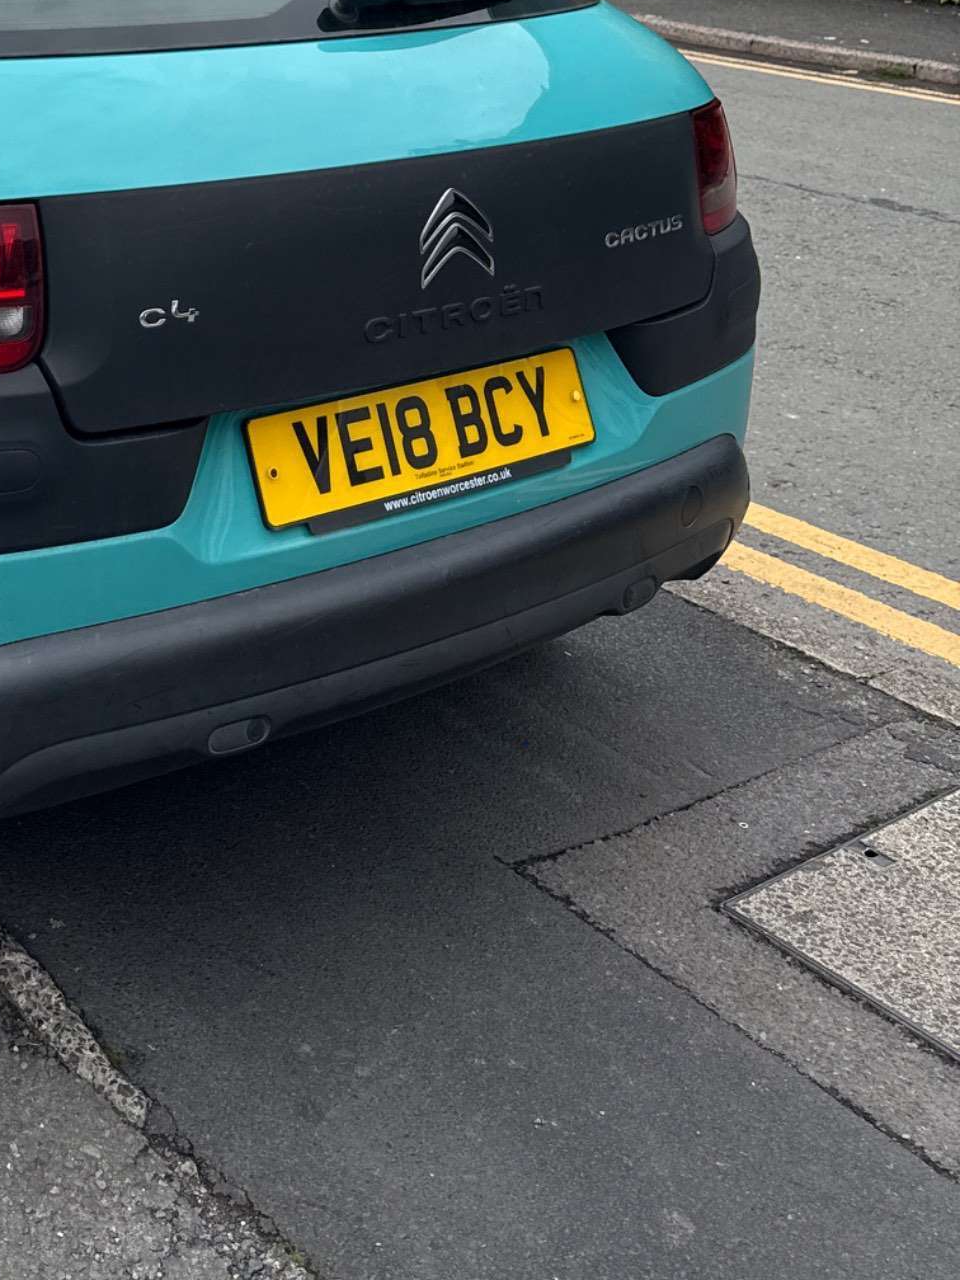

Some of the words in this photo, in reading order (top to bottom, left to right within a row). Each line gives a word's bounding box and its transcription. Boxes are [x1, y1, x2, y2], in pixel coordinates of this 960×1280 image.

[604, 214, 683, 249] CACTUS
[138, 299, 200, 328] C4
[362, 284, 545, 344] CITROËN
[292, 395, 438, 495] VE18
[444, 366, 550, 459] BCY
[383, 467, 512, 512] www.citroenworcester.co.uk
